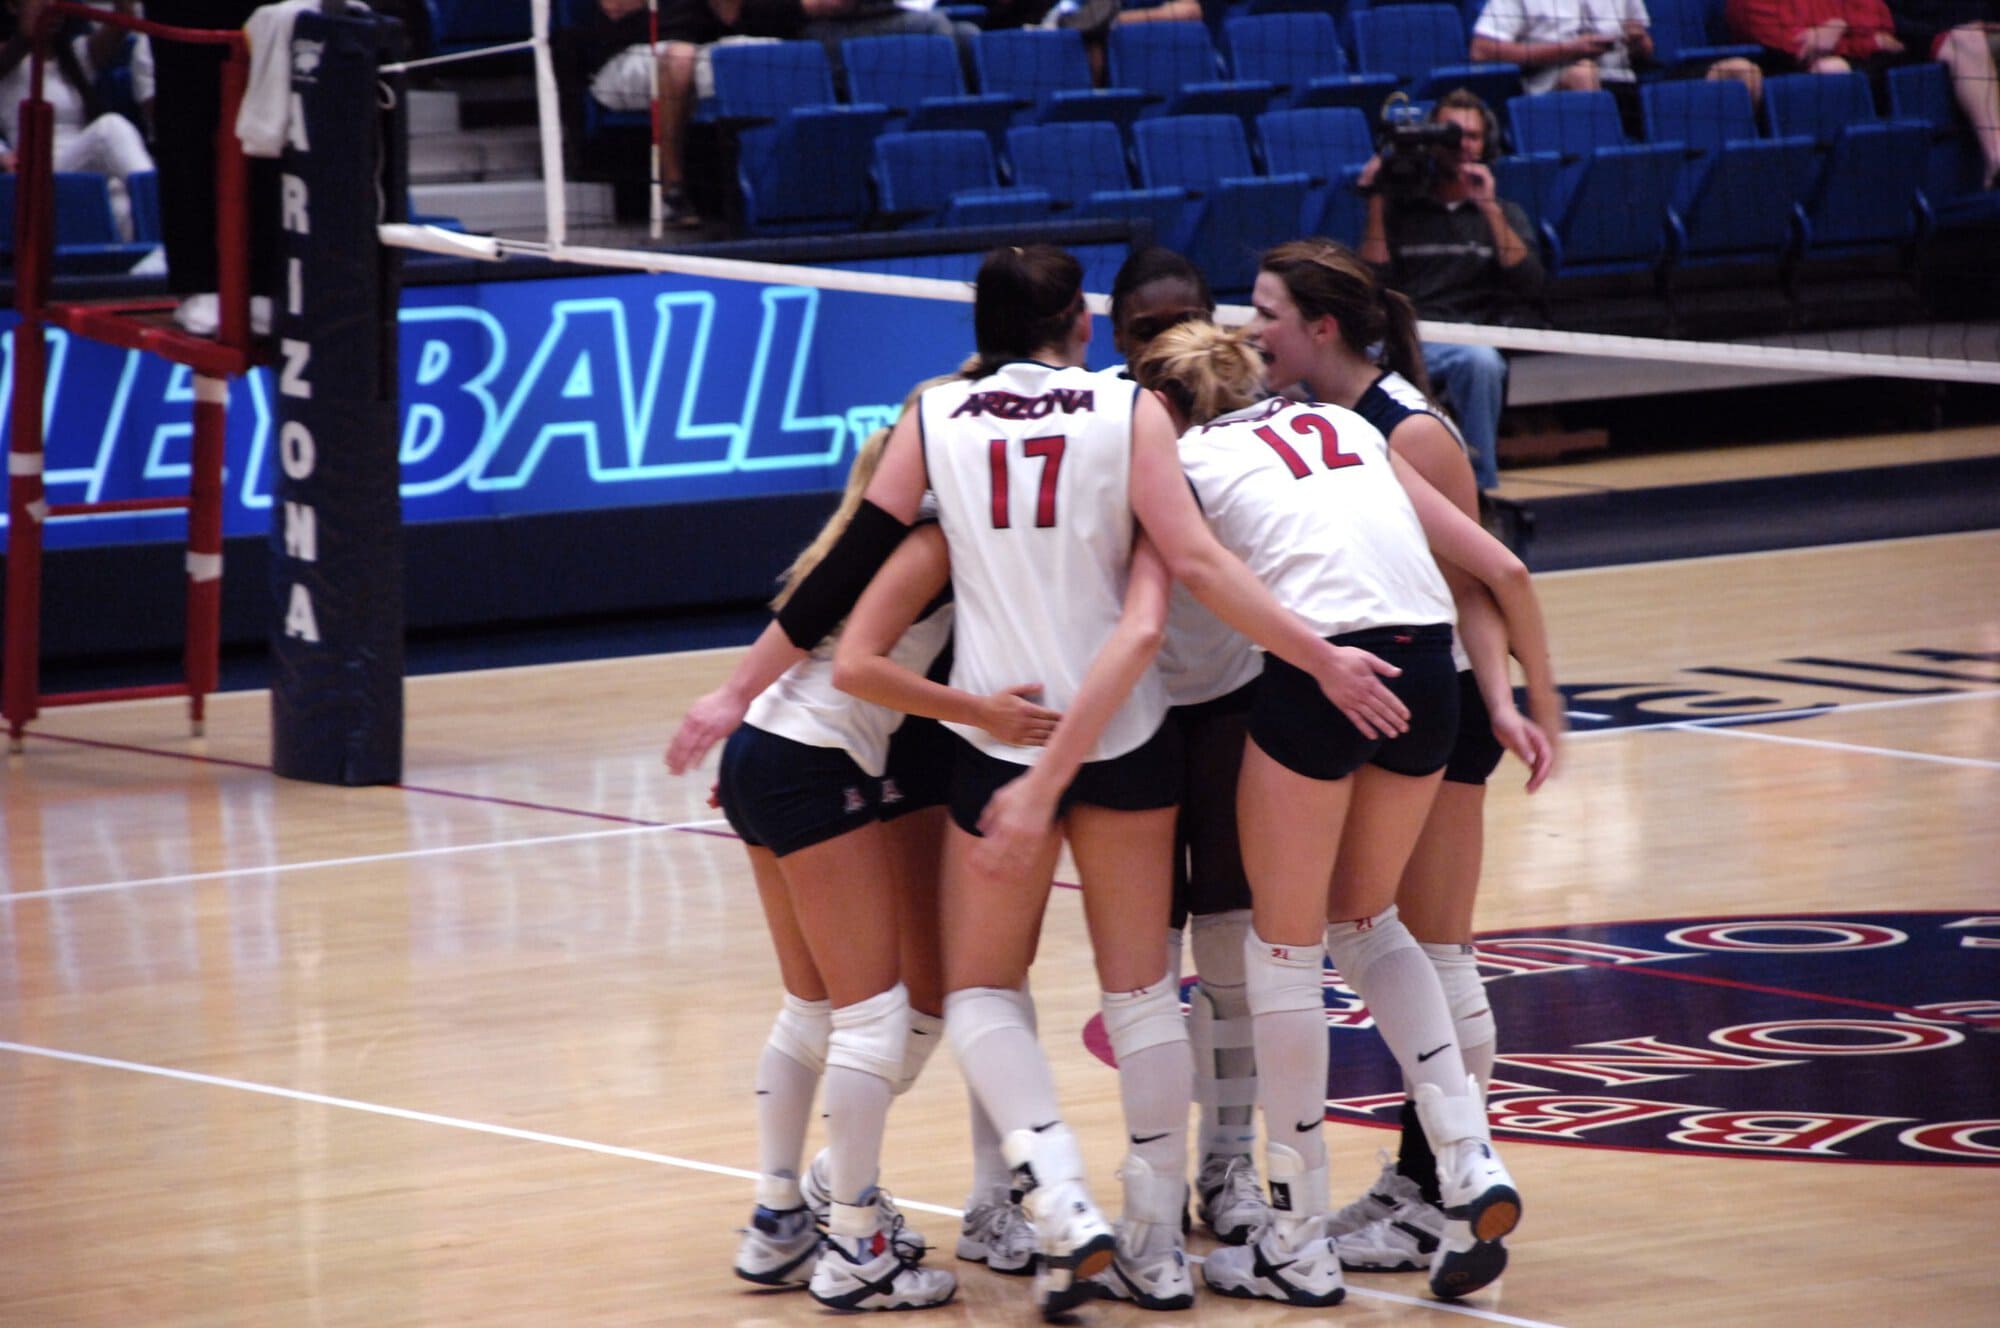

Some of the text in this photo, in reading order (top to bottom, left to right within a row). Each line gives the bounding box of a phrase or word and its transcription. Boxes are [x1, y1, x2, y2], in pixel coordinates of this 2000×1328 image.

[948, 388, 1096, 420] ARIZONA
[1252, 412, 1365, 480] 12
[988, 434, 1066, 529] 17
